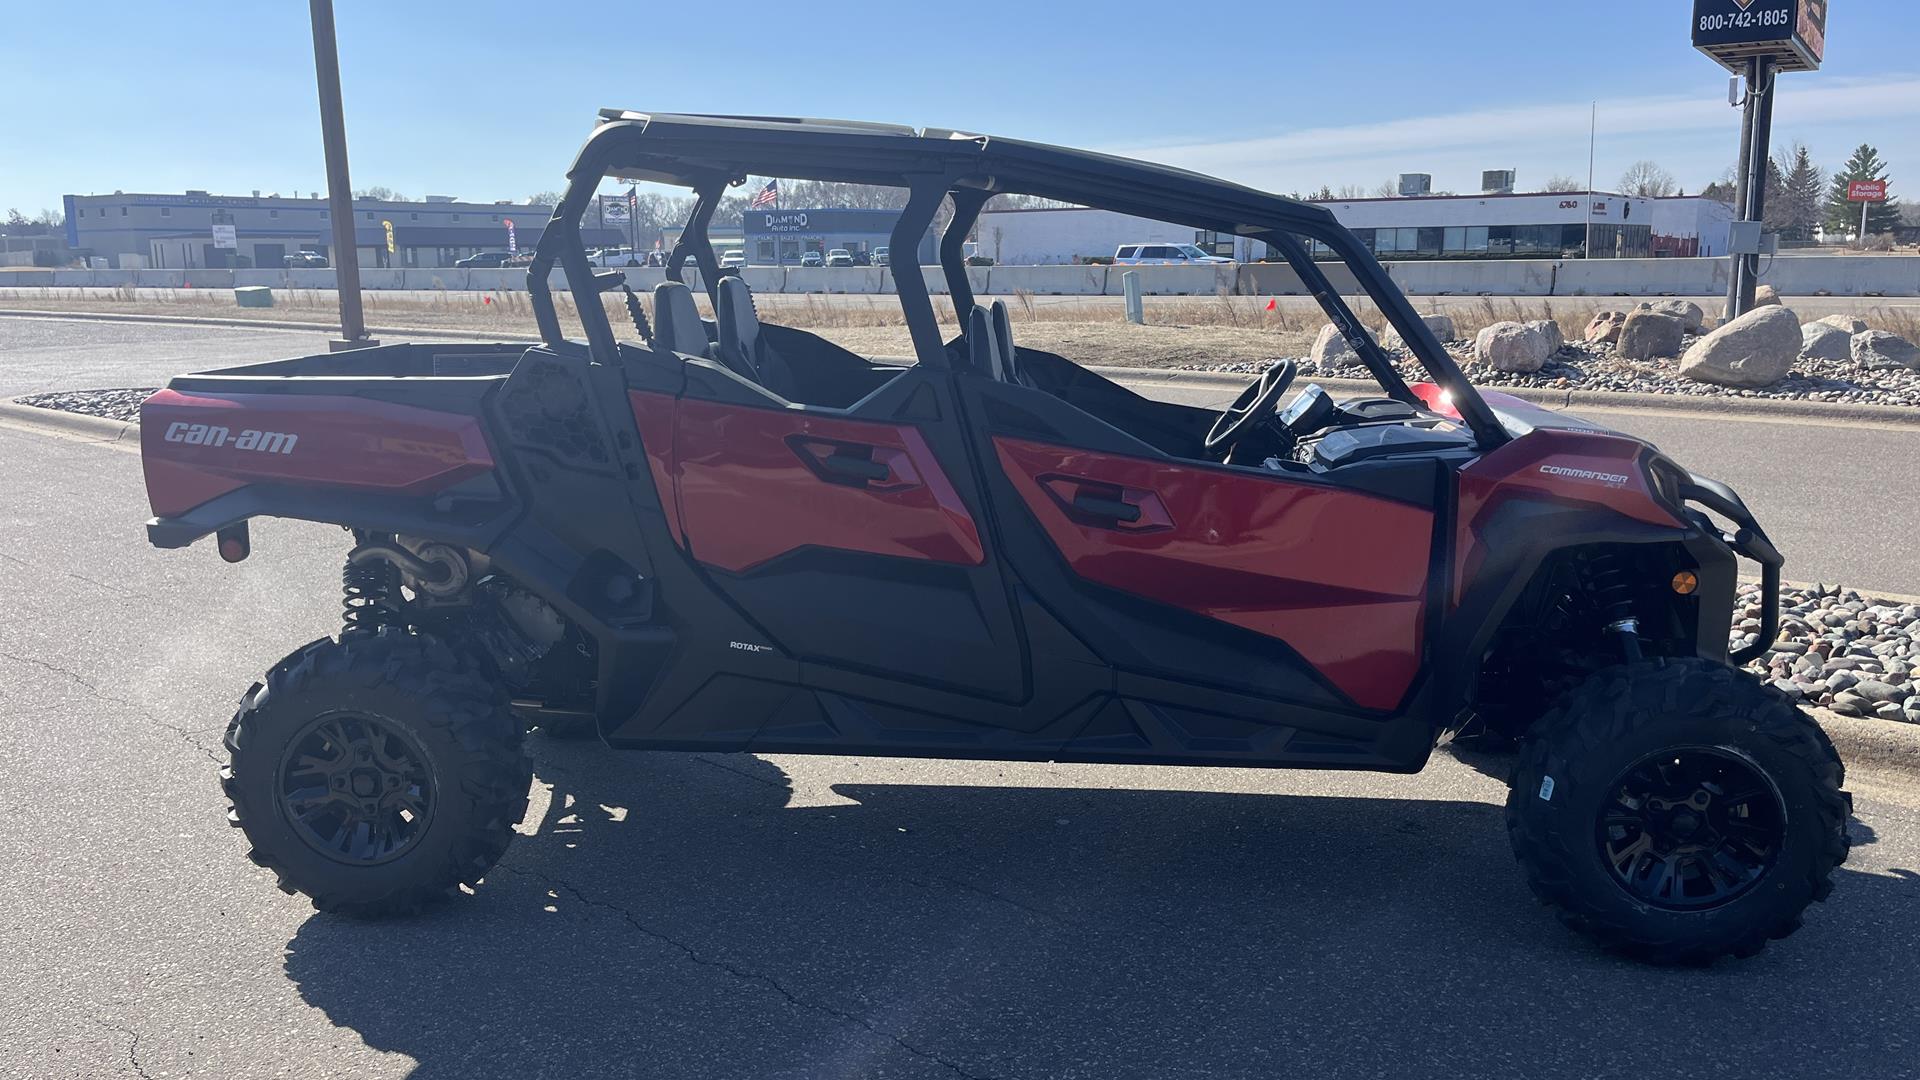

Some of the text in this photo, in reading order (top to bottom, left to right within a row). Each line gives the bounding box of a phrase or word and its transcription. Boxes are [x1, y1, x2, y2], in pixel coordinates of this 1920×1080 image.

[1699, 9, 1788, 31] 800-742-1805
[1851, 190, 1882, 198] Storage
[164, 421, 299, 455] can-am
[1540, 465, 1628, 483] COMMANDER
[730, 641, 760, 652] ROTAX
